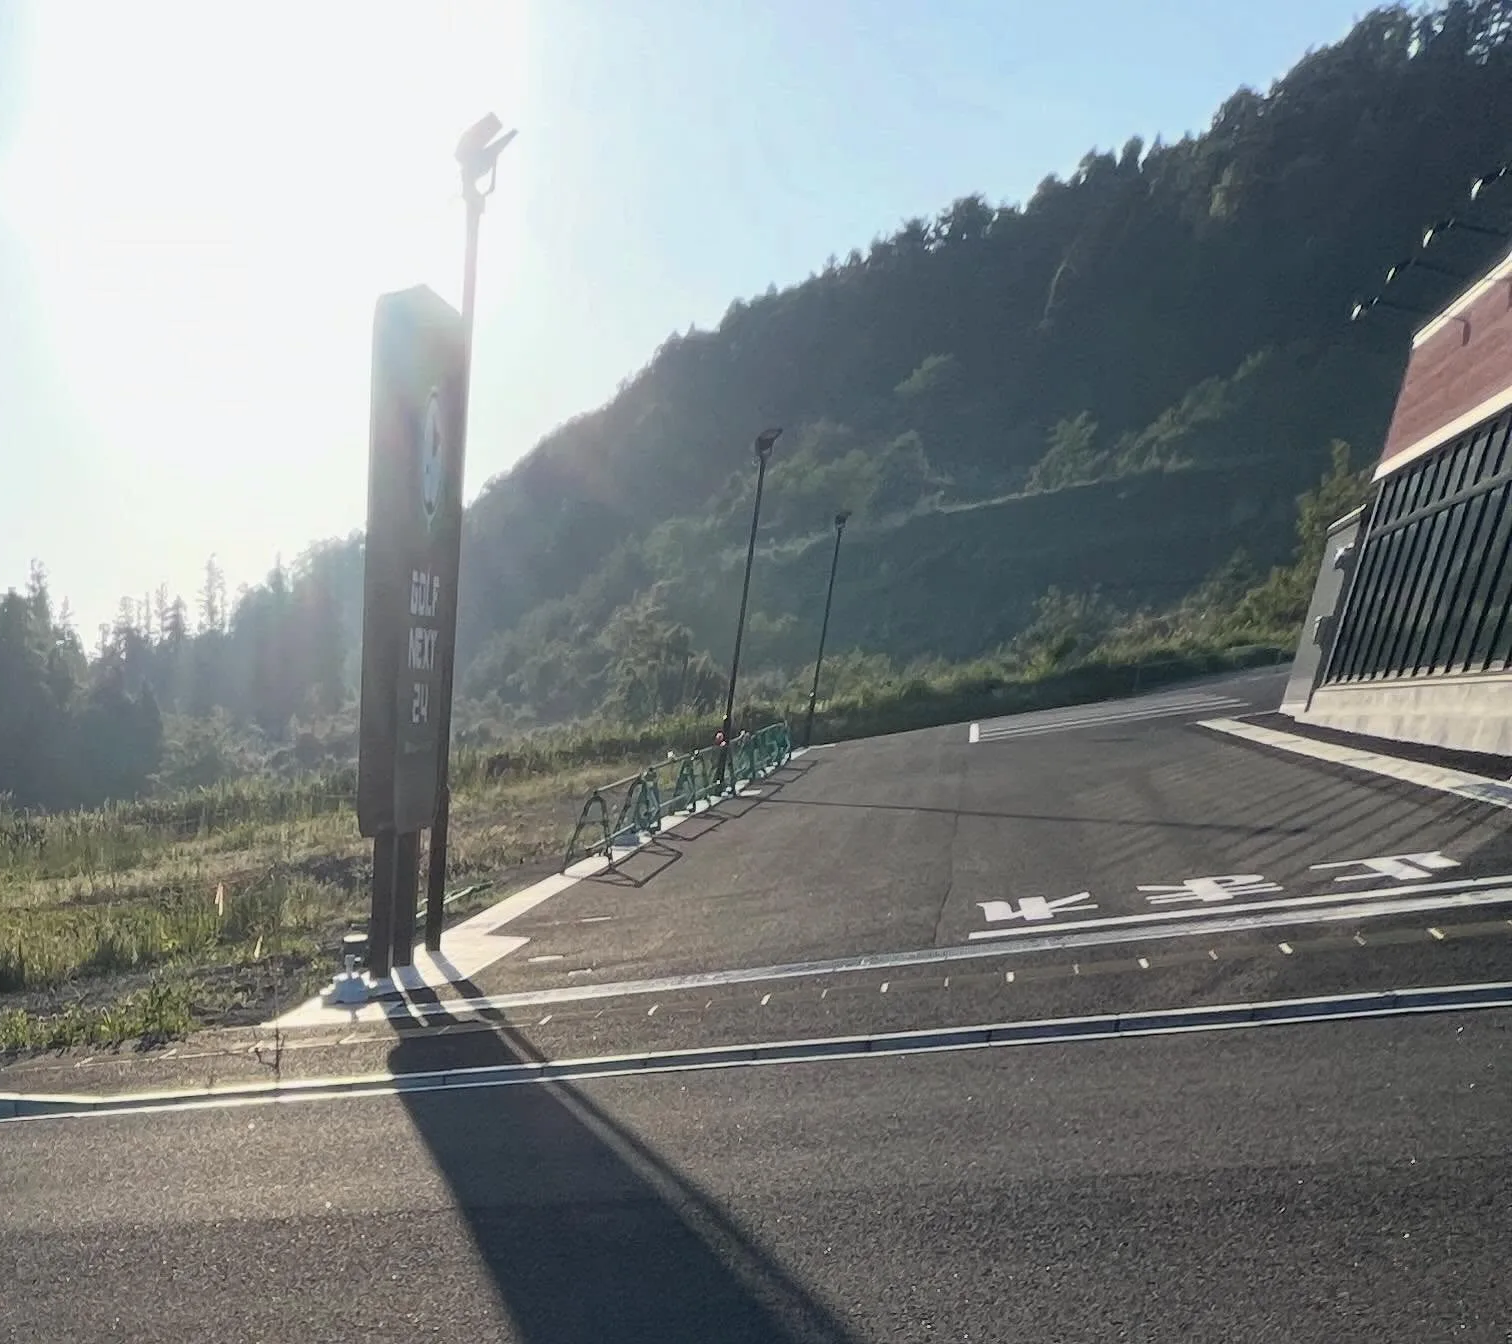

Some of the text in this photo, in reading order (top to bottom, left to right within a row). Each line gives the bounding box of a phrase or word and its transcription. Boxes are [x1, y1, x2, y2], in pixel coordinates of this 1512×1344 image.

[410, 569, 440, 617] GOLF
[412, 684, 429, 723] 24
[975, 851, 1462, 922] 止まれ
